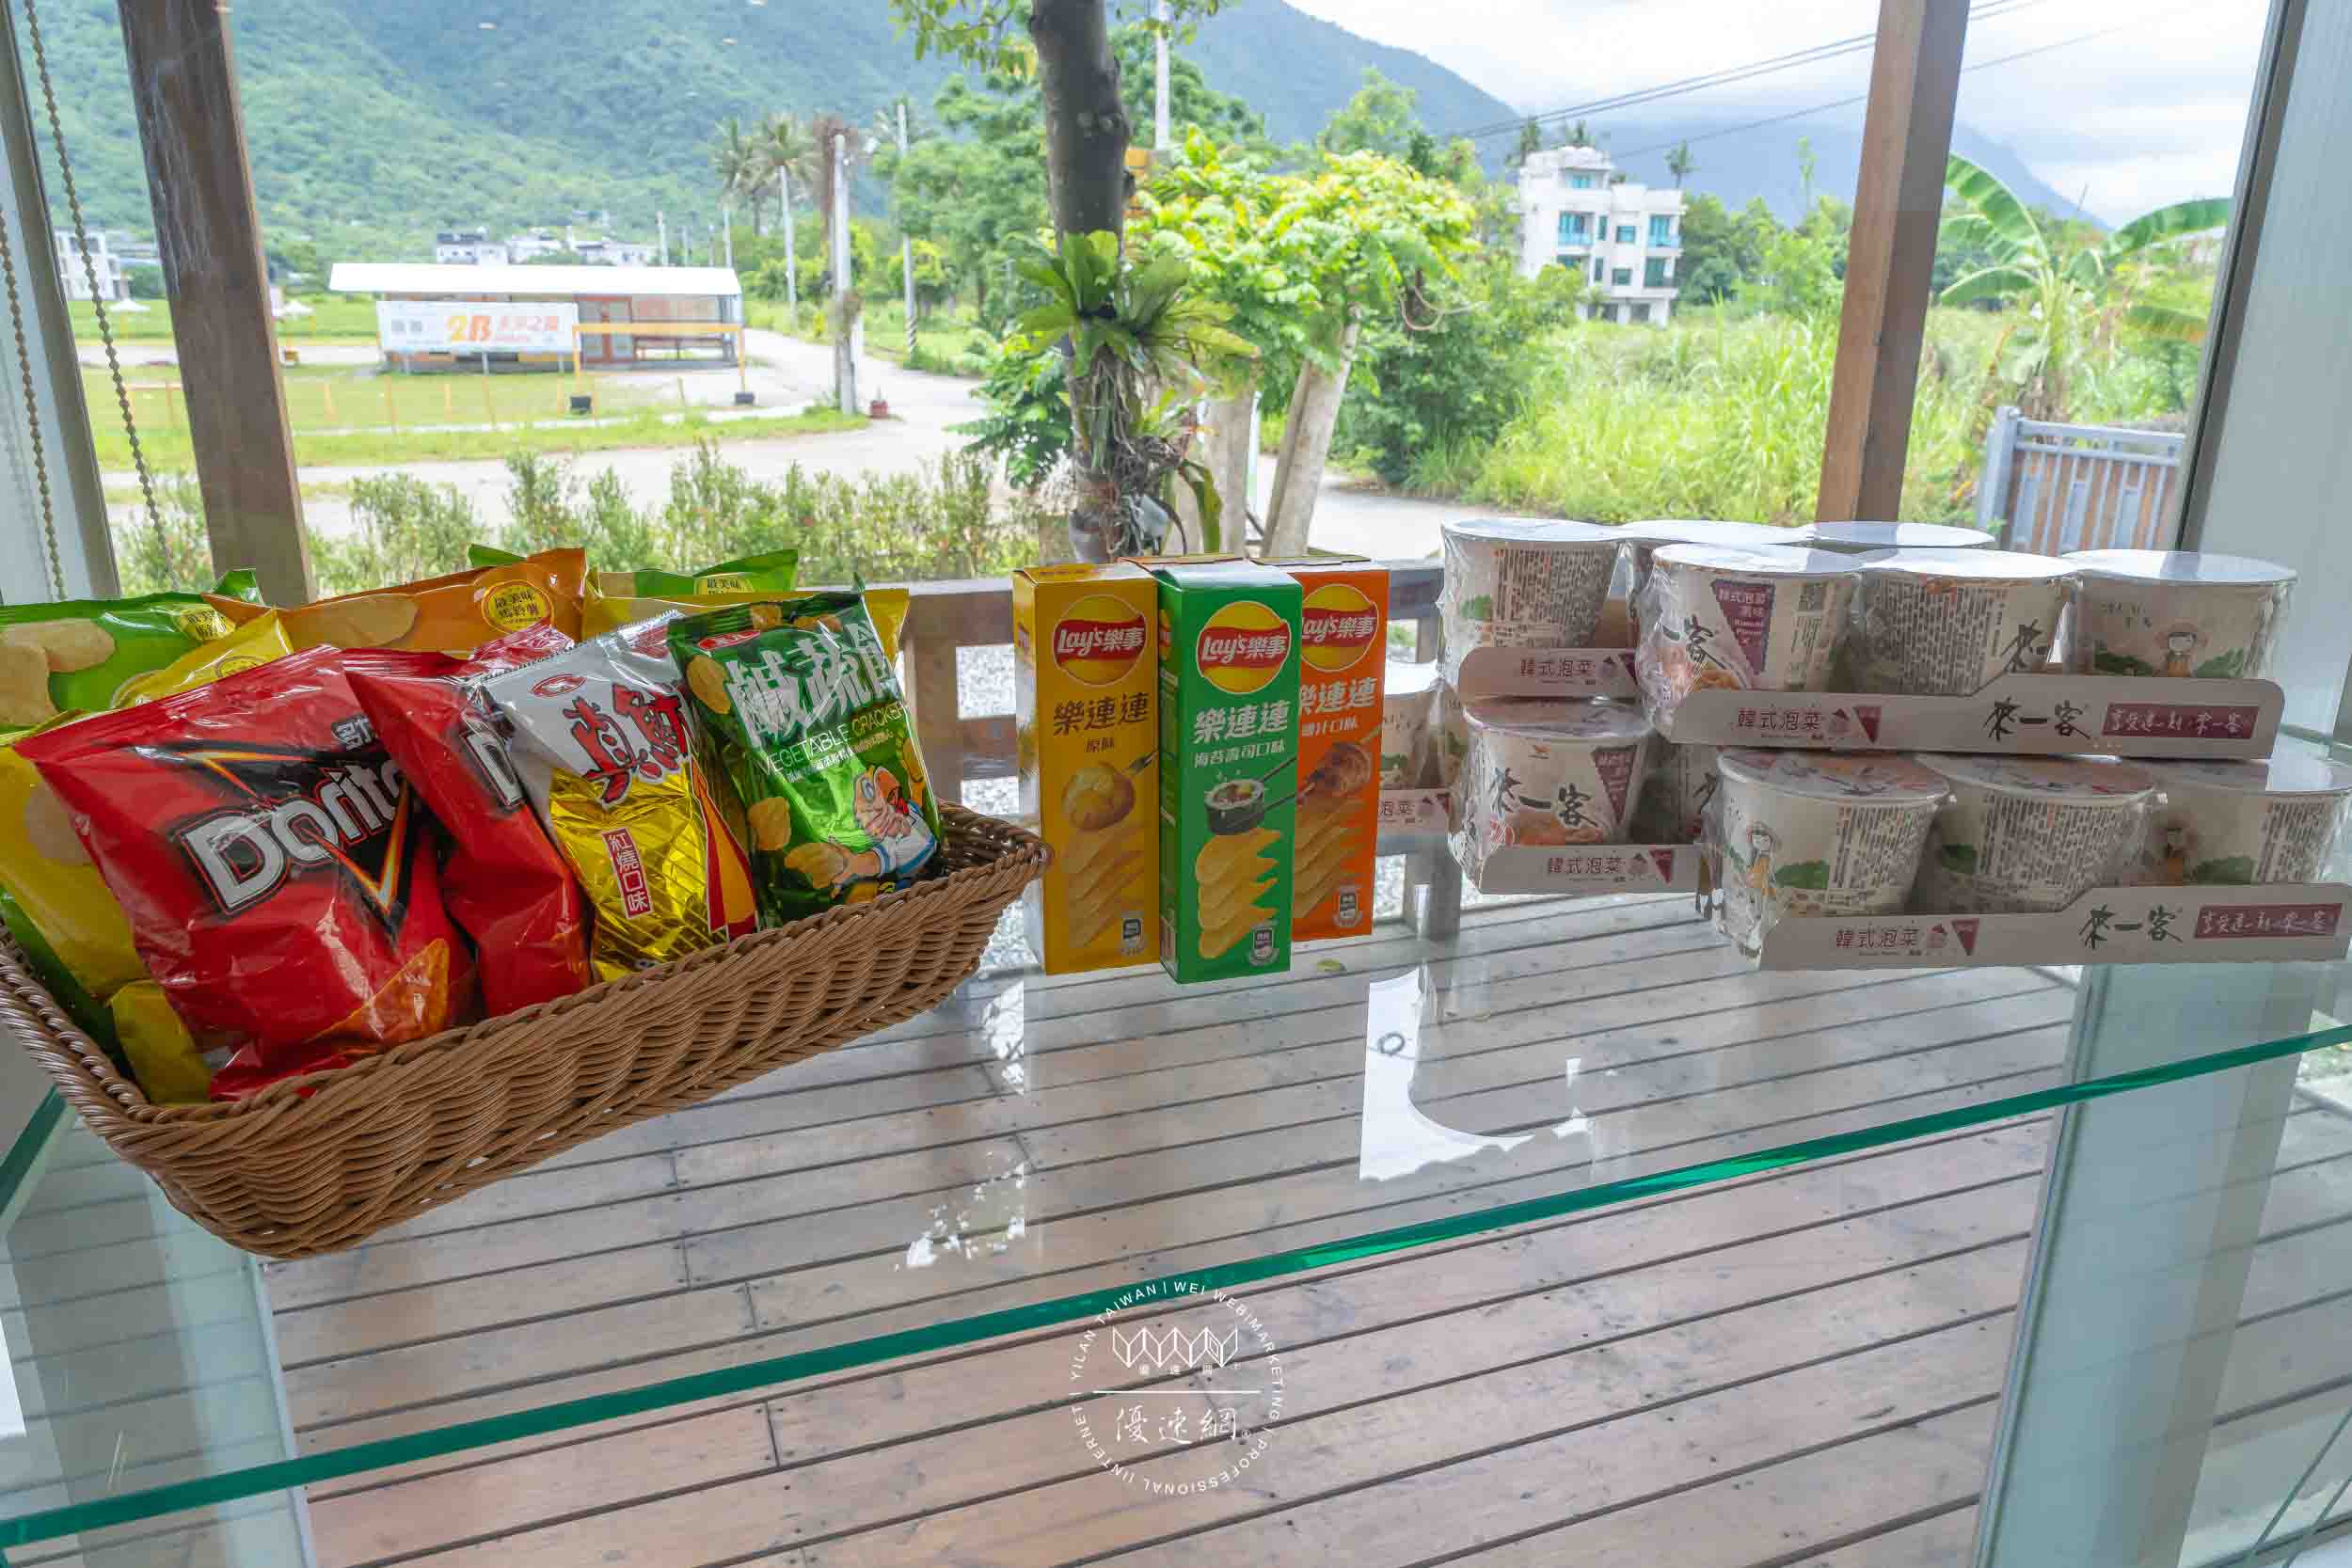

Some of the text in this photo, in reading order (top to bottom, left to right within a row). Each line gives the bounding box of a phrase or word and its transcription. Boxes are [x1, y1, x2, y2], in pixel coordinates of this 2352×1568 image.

[1057, 626, 1144, 656] Lay's 樂事
[1202, 635, 1287, 663] Lay's 樂事
[1053, 692, 1149, 736] 樂連連
[1193, 700, 1291, 744] 樂連連
[1739, 707, 1821, 731] 韓式泡菜
[1982, 697, 2091, 741] 來一客
[764, 725, 851, 775] VEGETABLE
[185, 758, 407, 910] Dorito
[609, 832, 649, 911] 紅燒口味
[1549, 857, 1624, 875] 韓式泡菜
[1836, 926, 1919, 948] 韓式泡菜
